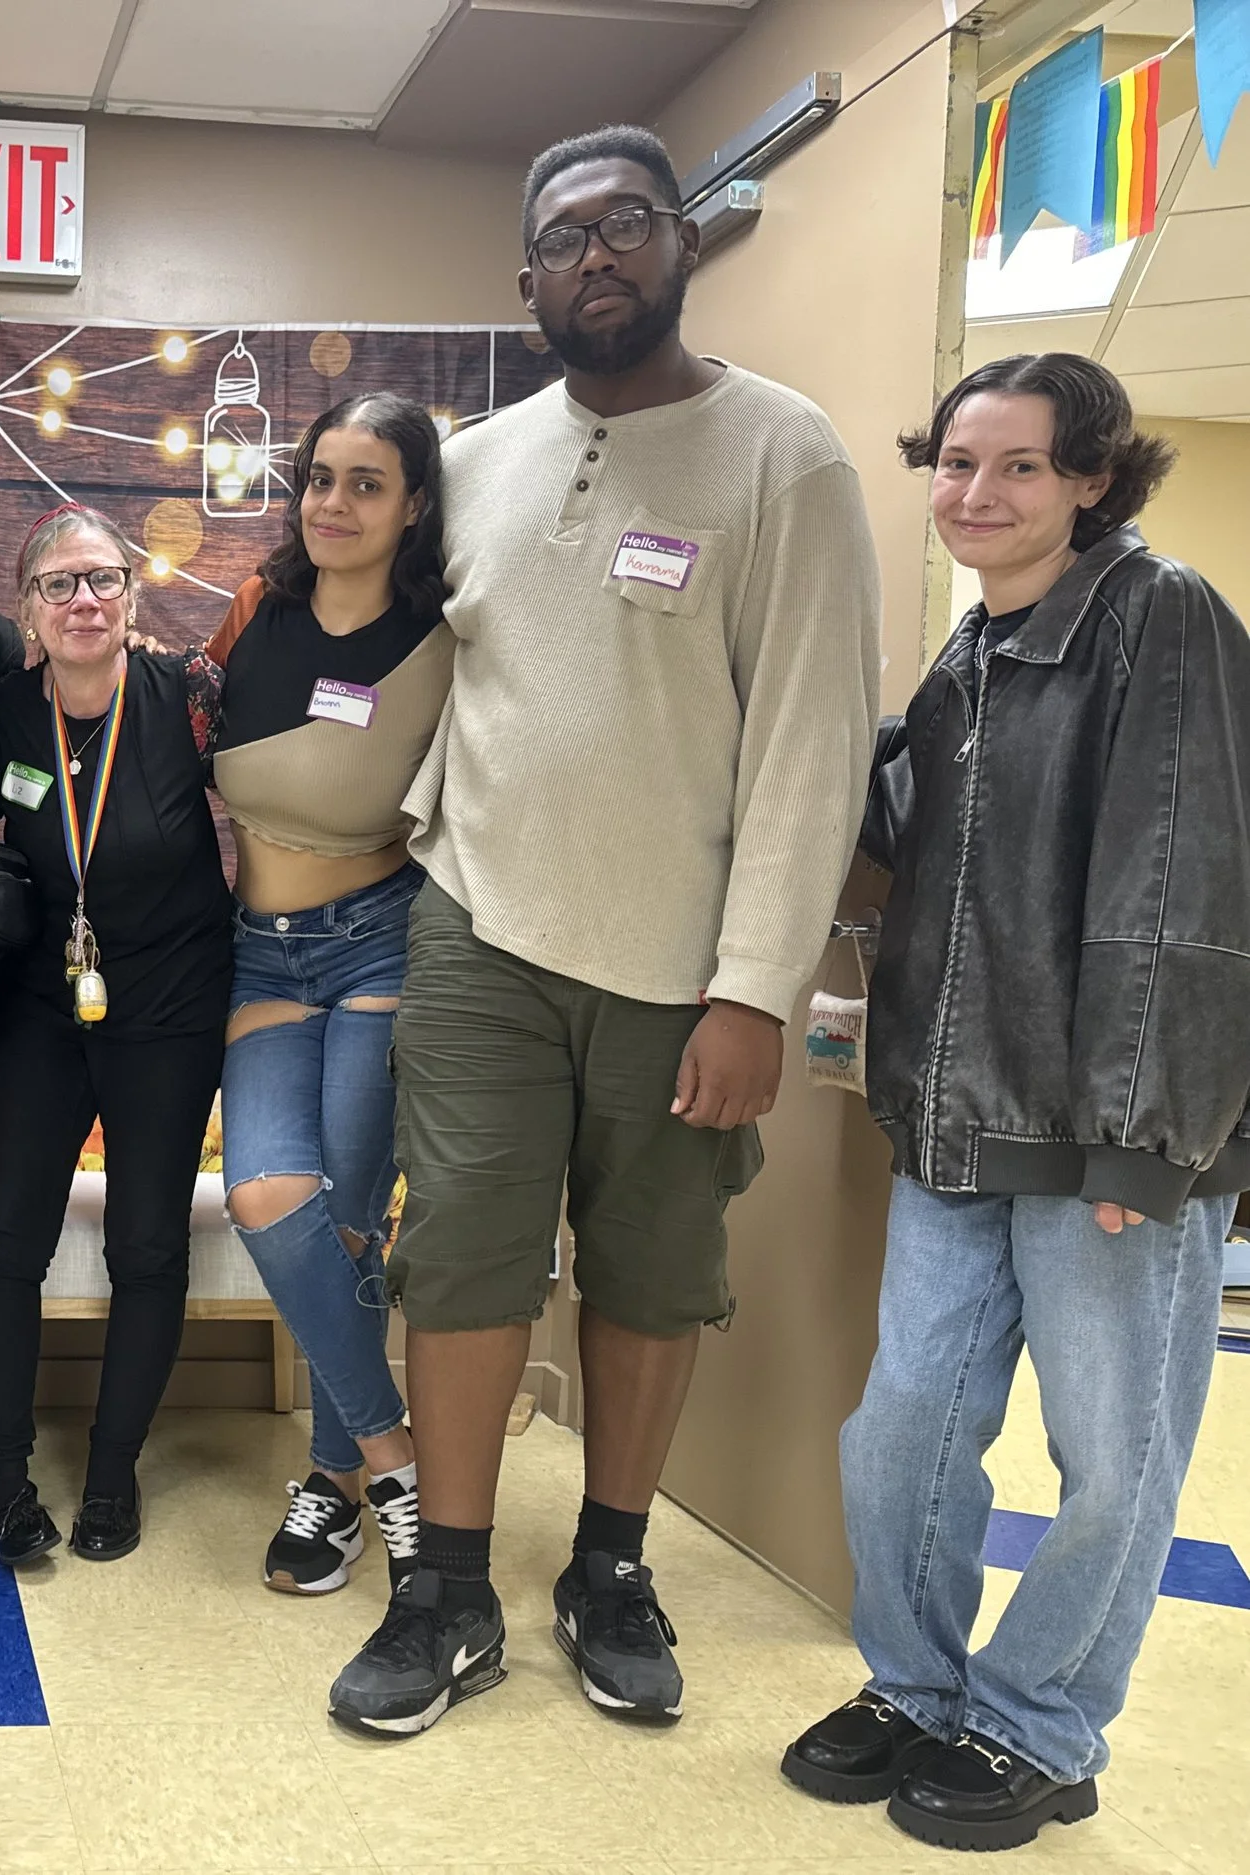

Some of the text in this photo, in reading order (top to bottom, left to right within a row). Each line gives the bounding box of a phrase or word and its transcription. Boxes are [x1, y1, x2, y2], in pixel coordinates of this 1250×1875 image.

[622, 534, 657, 550] Hello
[666, 547, 682, 556] name
[316, 680, 347, 695] Hello
[10, 763, 28, 778] Hello
[834, 1011, 862, 1039] PATCH
